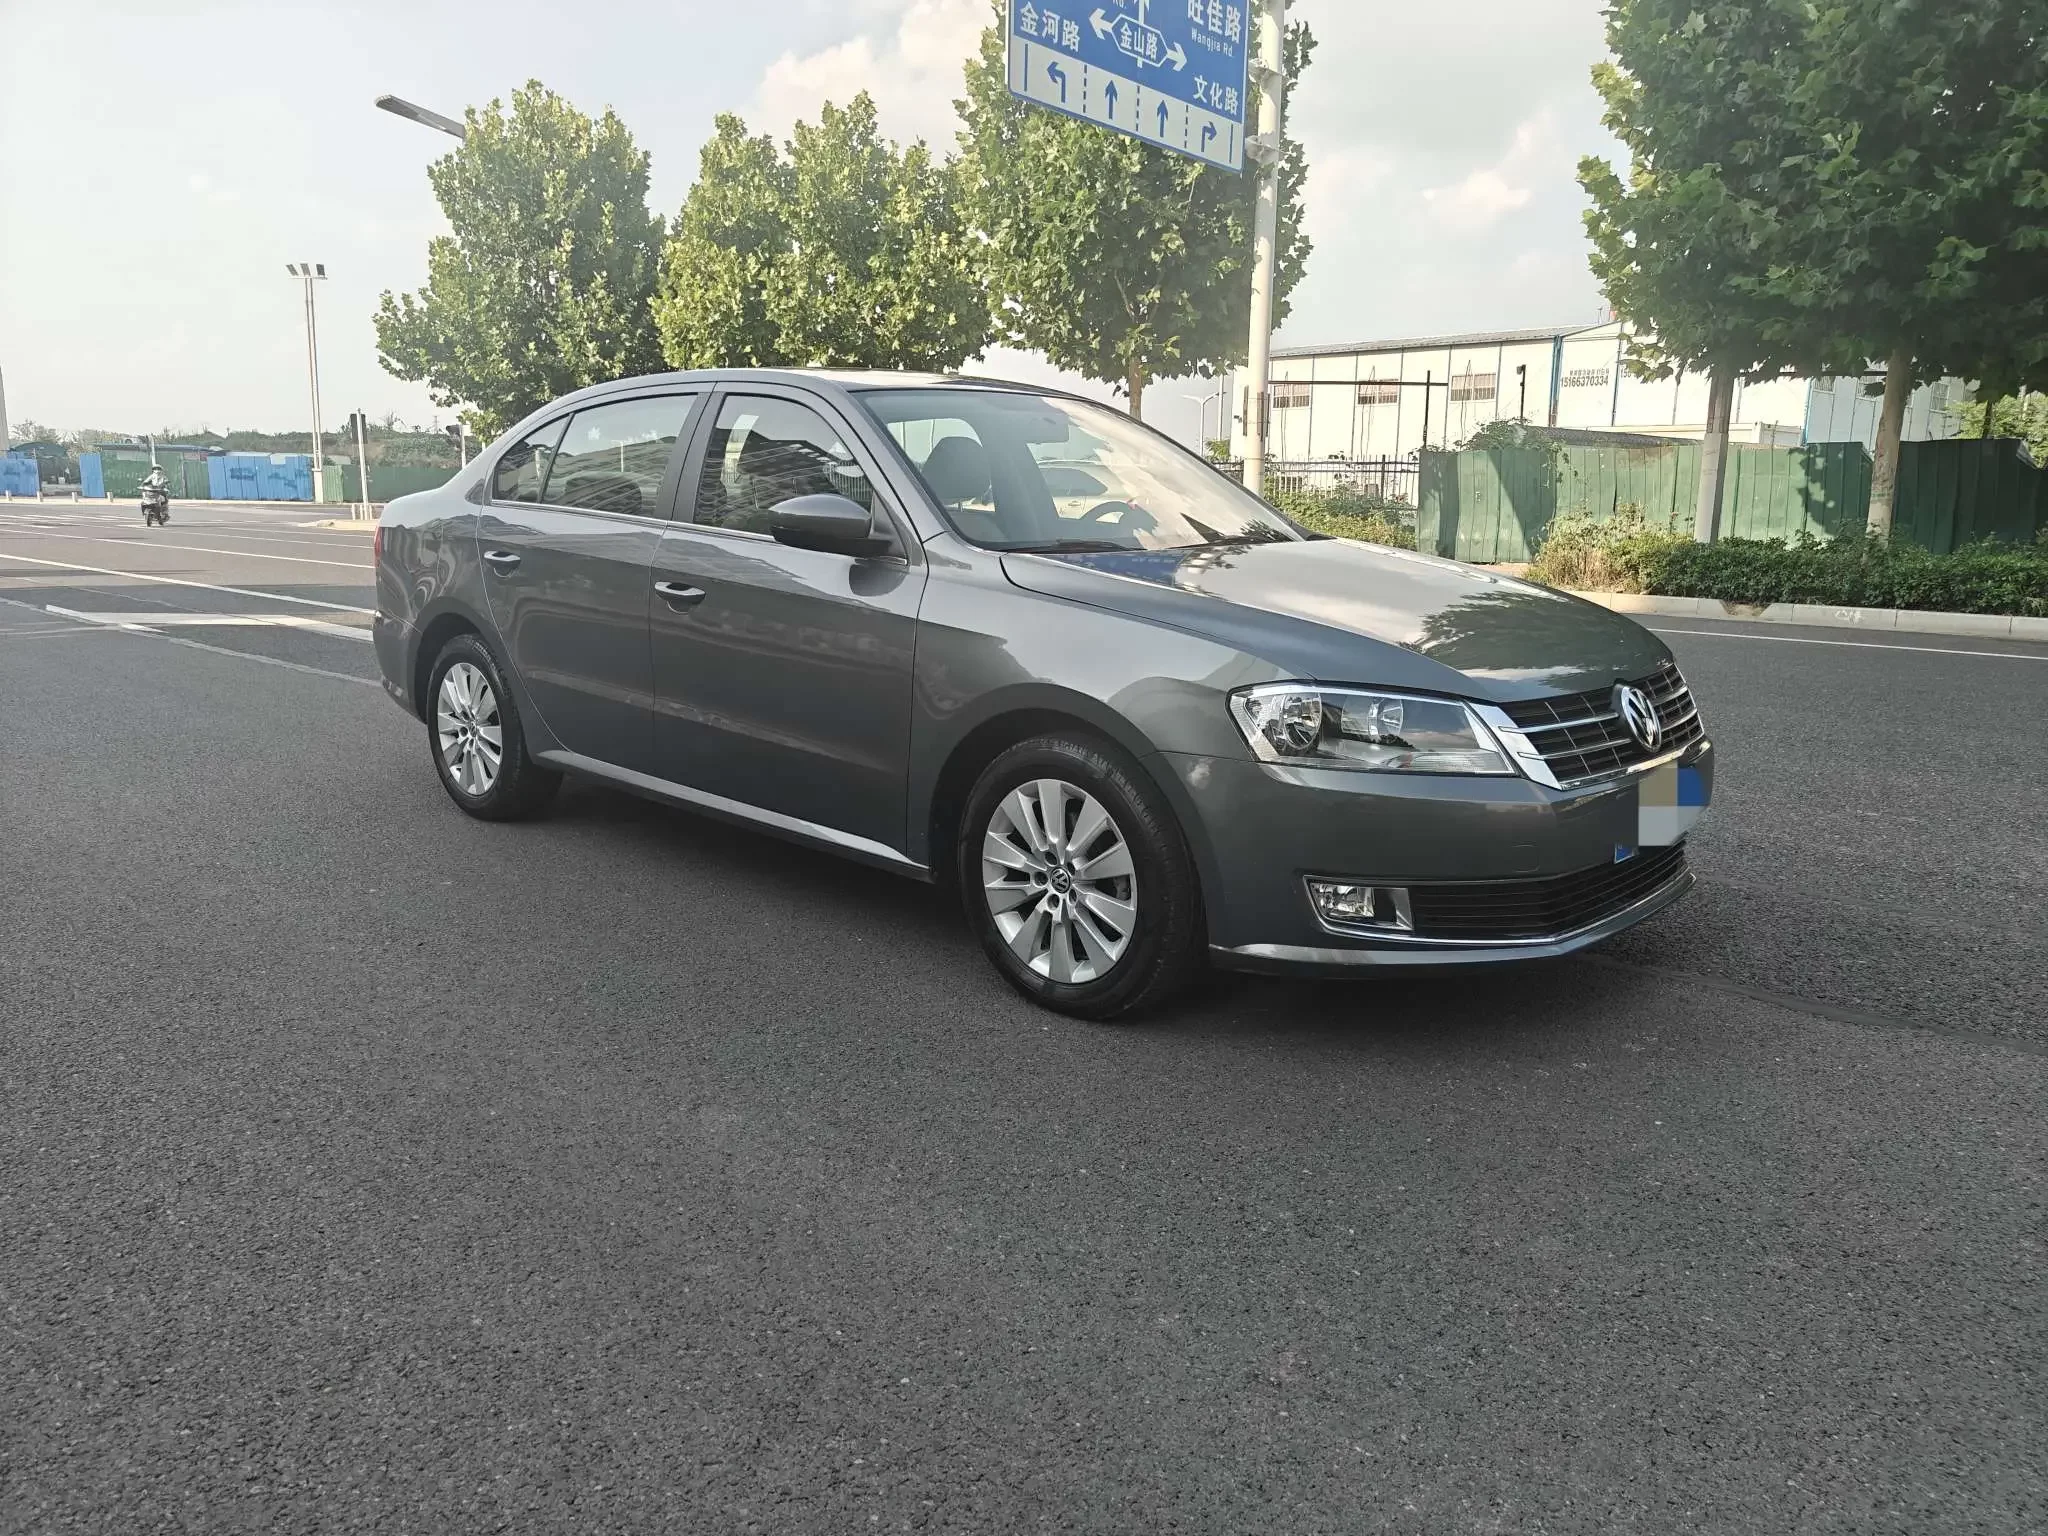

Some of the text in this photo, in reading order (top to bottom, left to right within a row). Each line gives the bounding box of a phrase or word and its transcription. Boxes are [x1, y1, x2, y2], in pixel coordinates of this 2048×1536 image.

[1020, 1, 1080, 52] 金河路
[1120, 22, 1158, 61] 金山路
[1187, 0, 1241, 44] 旺佳路
[1191, 27, 1221, 52] Wangjia
[1193, 75, 1239, 116] 文化路
